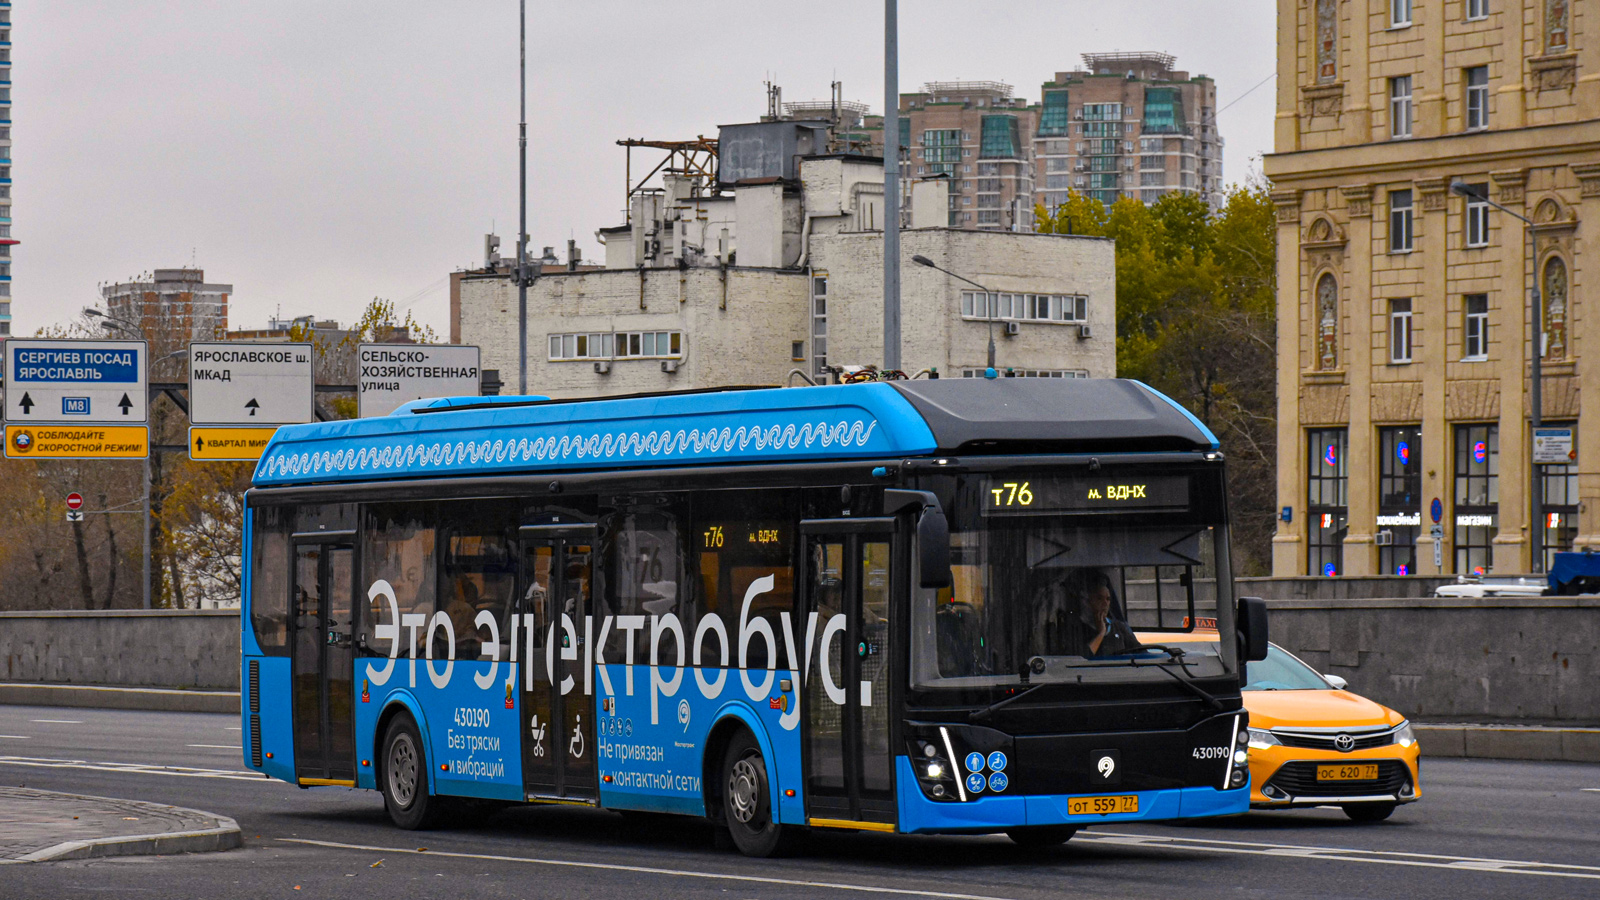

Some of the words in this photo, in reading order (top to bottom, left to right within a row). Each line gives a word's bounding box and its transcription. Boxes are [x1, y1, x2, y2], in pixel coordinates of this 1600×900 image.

[19, 352, 81, 364] СЕРГИЕВ
[84, 353, 132, 366] ПОСАД
[194, 352, 293, 363] ЯРОСЛАВСКОЕ
[296, 354, 310, 363] ш.
[361, 351, 430, 363] СЕЛЬСКО-
[19, 367, 102, 380] ЯРОСЛАВЛЬ
[361, 363, 478, 379] ХОЗЯЙСТВЕННАЯ
[361, 380, 400, 393] улица
[67, 400, 85, 412] М8
[37, 430, 105, 440] СОБЛЮДАЙТЕ
[37, 443, 102, 453] СКОРОСТНОЙ
[105, 443, 142, 454] РЕЖИМ!
[207, 439, 246, 448] КВАРТАЛ
[248, 439, 270, 448] МИР
[991, 482, 1033, 506] т76
[1106, 484, 1147, 499] ВДНХ
[1456, 515, 1492, 526] магазин
[703, 526, 724, 548] т76
[758, 529, 778, 543] ВДНХ
[1194, 619, 1217, 628] TAXI
[365, 578, 457, 690] Это
[474, 573, 872, 730] электробус.
[454, 708, 490, 728] 430190
[448, 729, 465, 750] Без
[467, 734, 501, 758] тряски
[598, 737, 613, 759] Не
[615, 743, 664, 763] привязан
[1192, 747, 1231, 759] 430190
[448, 762, 455, 773] и
[457, 758, 505, 778] вибраций
[1340, 767, 1360, 778] 620
[1365, 766, 1375, 774] 77
[612, 771, 673, 791] контактной
[675, 776, 700, 792] сети
[1094, 799, 1116, 811] 559
[1123, 797, 1134, 806] 77
